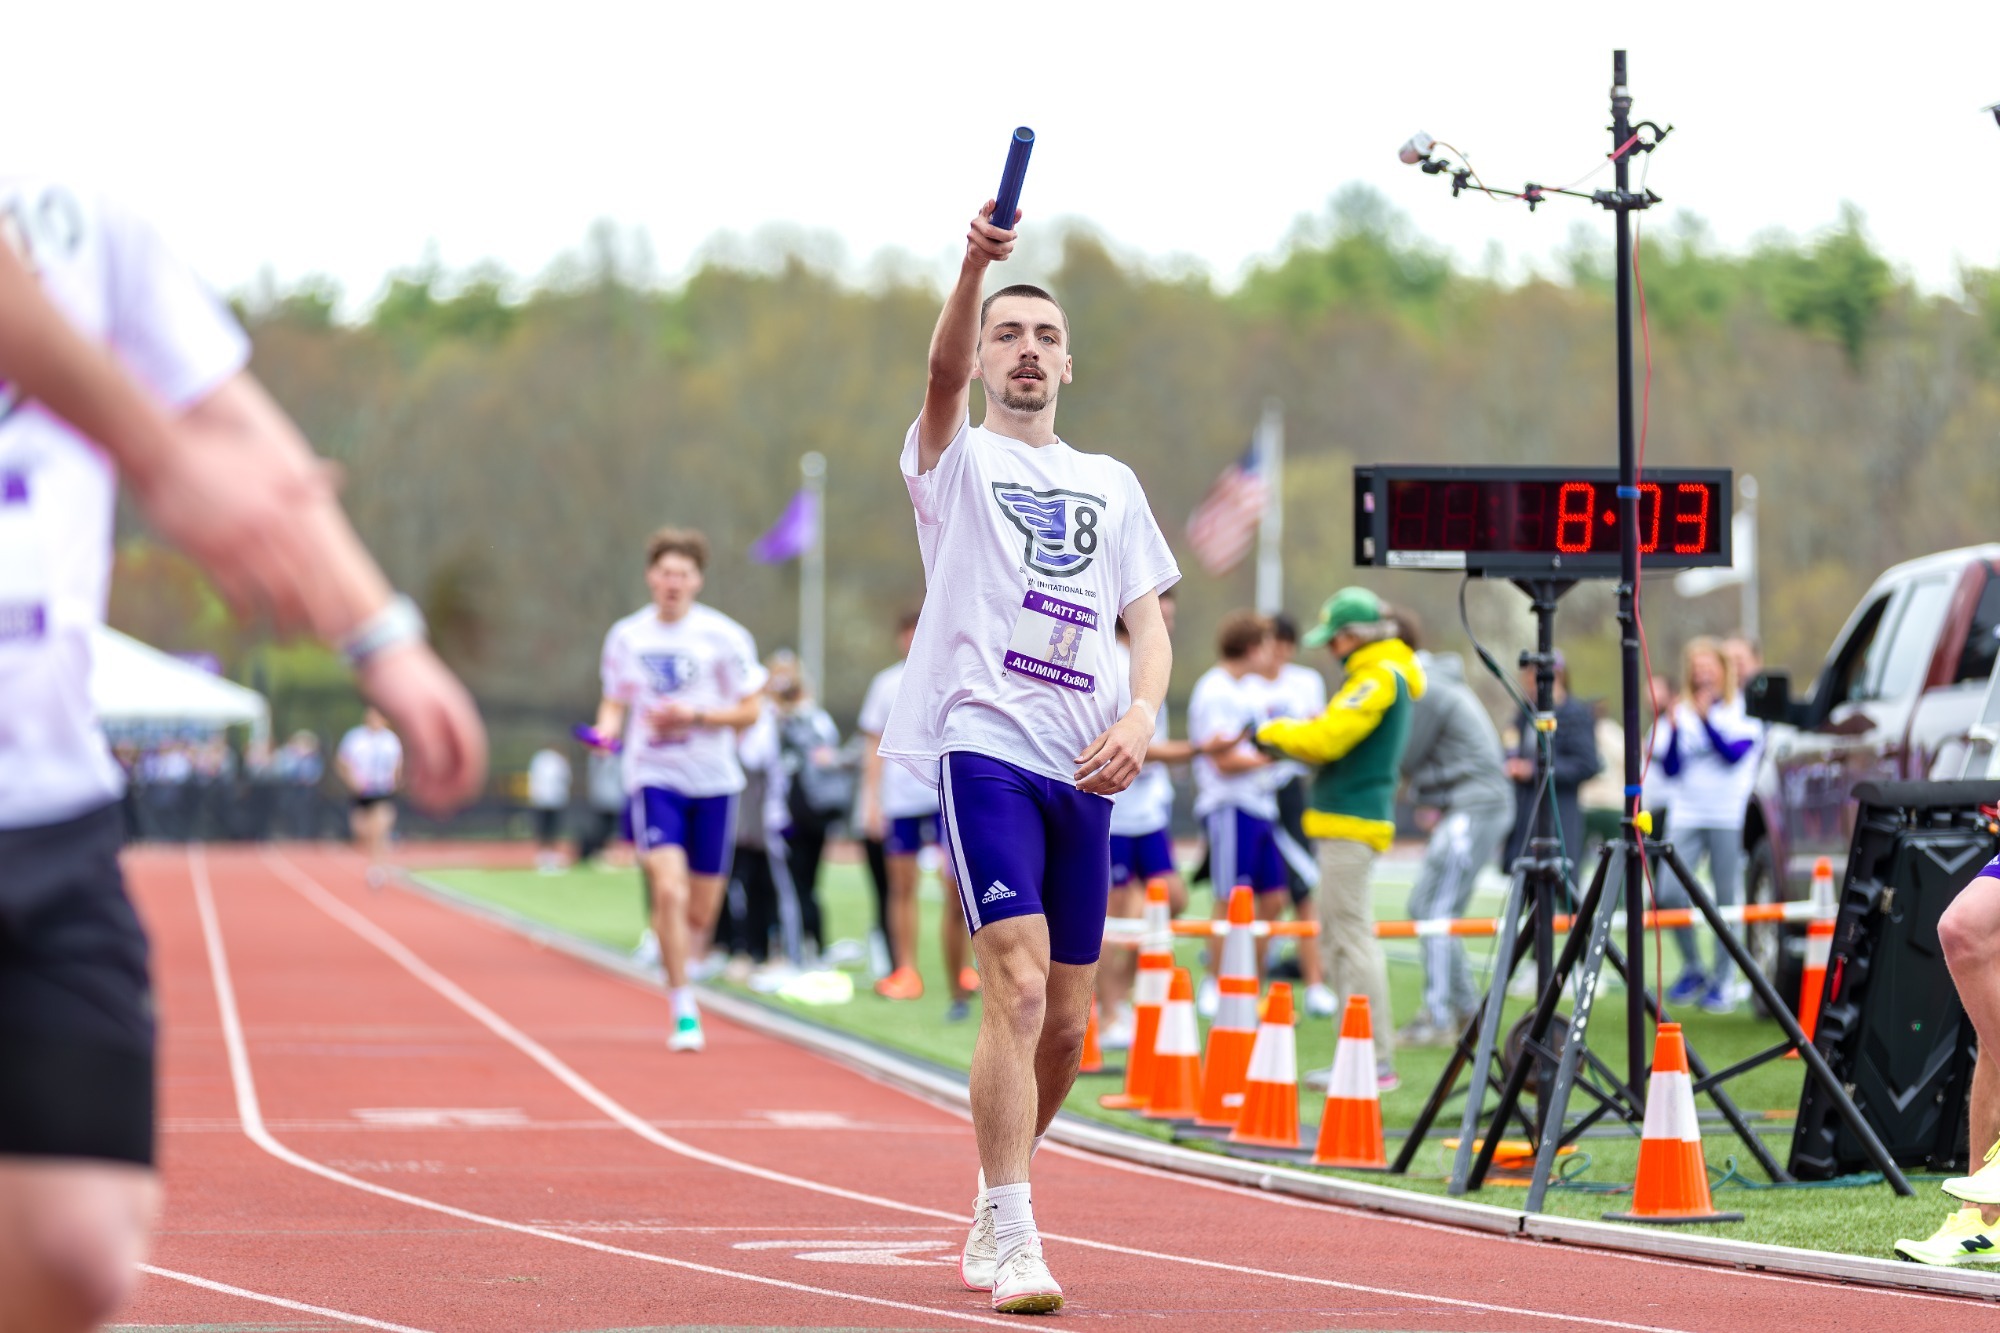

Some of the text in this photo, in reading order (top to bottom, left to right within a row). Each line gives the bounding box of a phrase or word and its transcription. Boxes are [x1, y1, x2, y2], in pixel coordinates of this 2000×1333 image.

[1073, 505, 1098, 556] 8
[1041, 599, 1075, 619] MATT
[1012, 656, 1061, 681] ALUMNI
[1061, 672, 1089, 689] 4x800
[981, 889, 1018, 905] adidas
